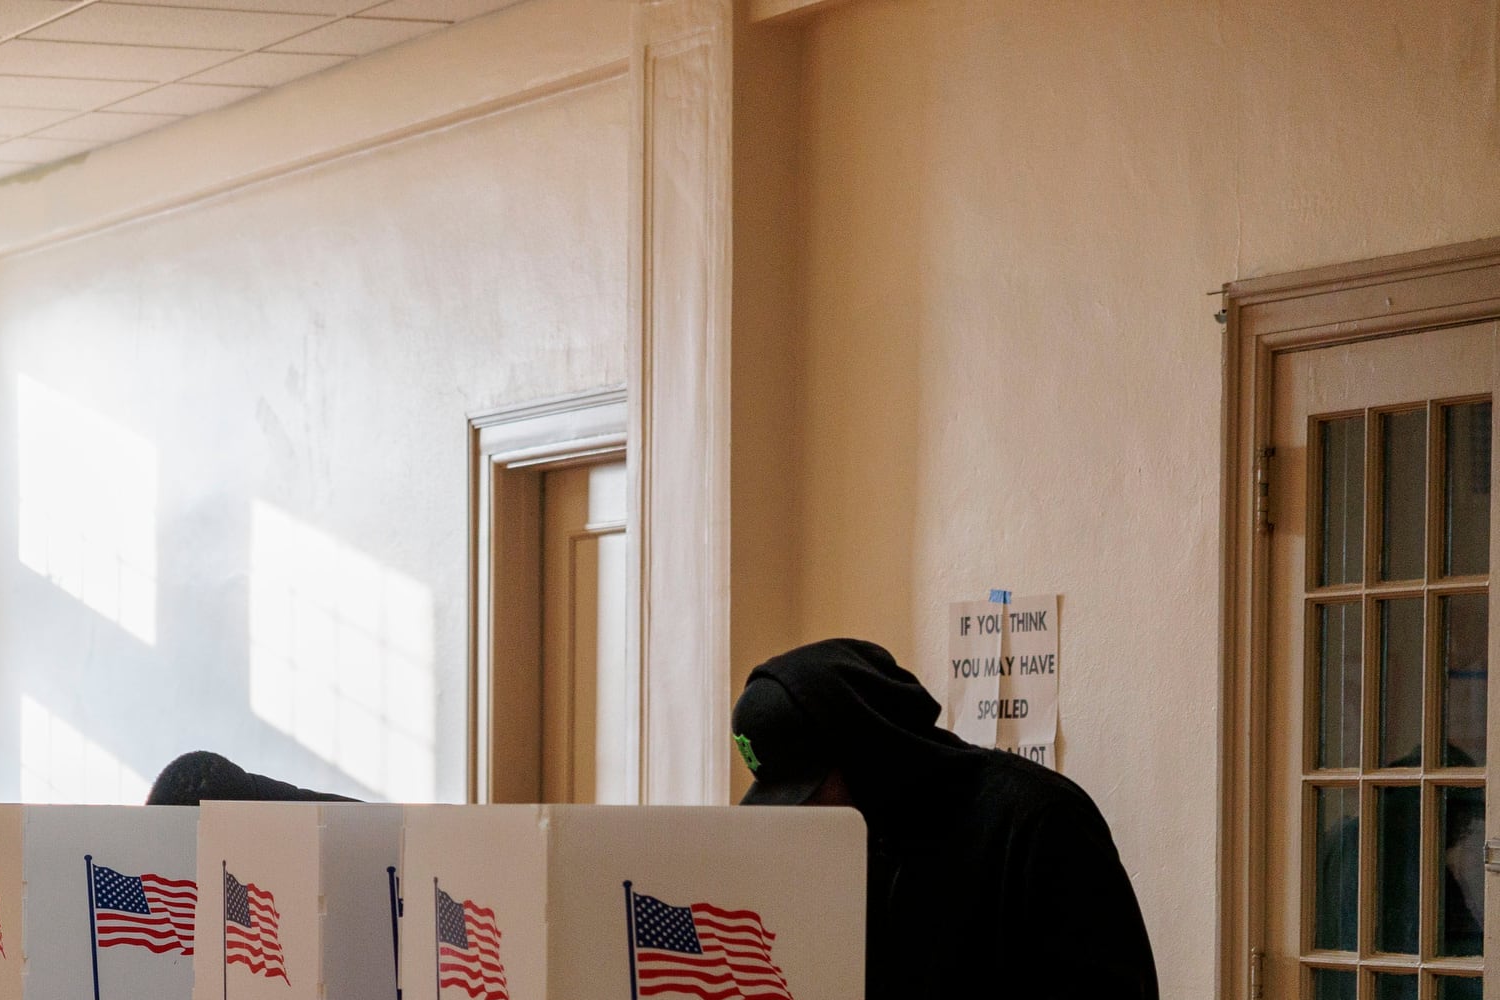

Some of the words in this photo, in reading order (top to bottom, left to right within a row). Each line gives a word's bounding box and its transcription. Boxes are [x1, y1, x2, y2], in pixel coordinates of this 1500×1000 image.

[960, 616, 971, 636] IF
[977, 614, 1001, 635] YOU
[1009, 610, 1048, 633] THINK
[952, 658, 980, 679] YOU
[983, 656, 1015, 677] MAY
[1020, 654, 1055, 676] HAVE
[977, 699, 1029, 720] SPOILED
